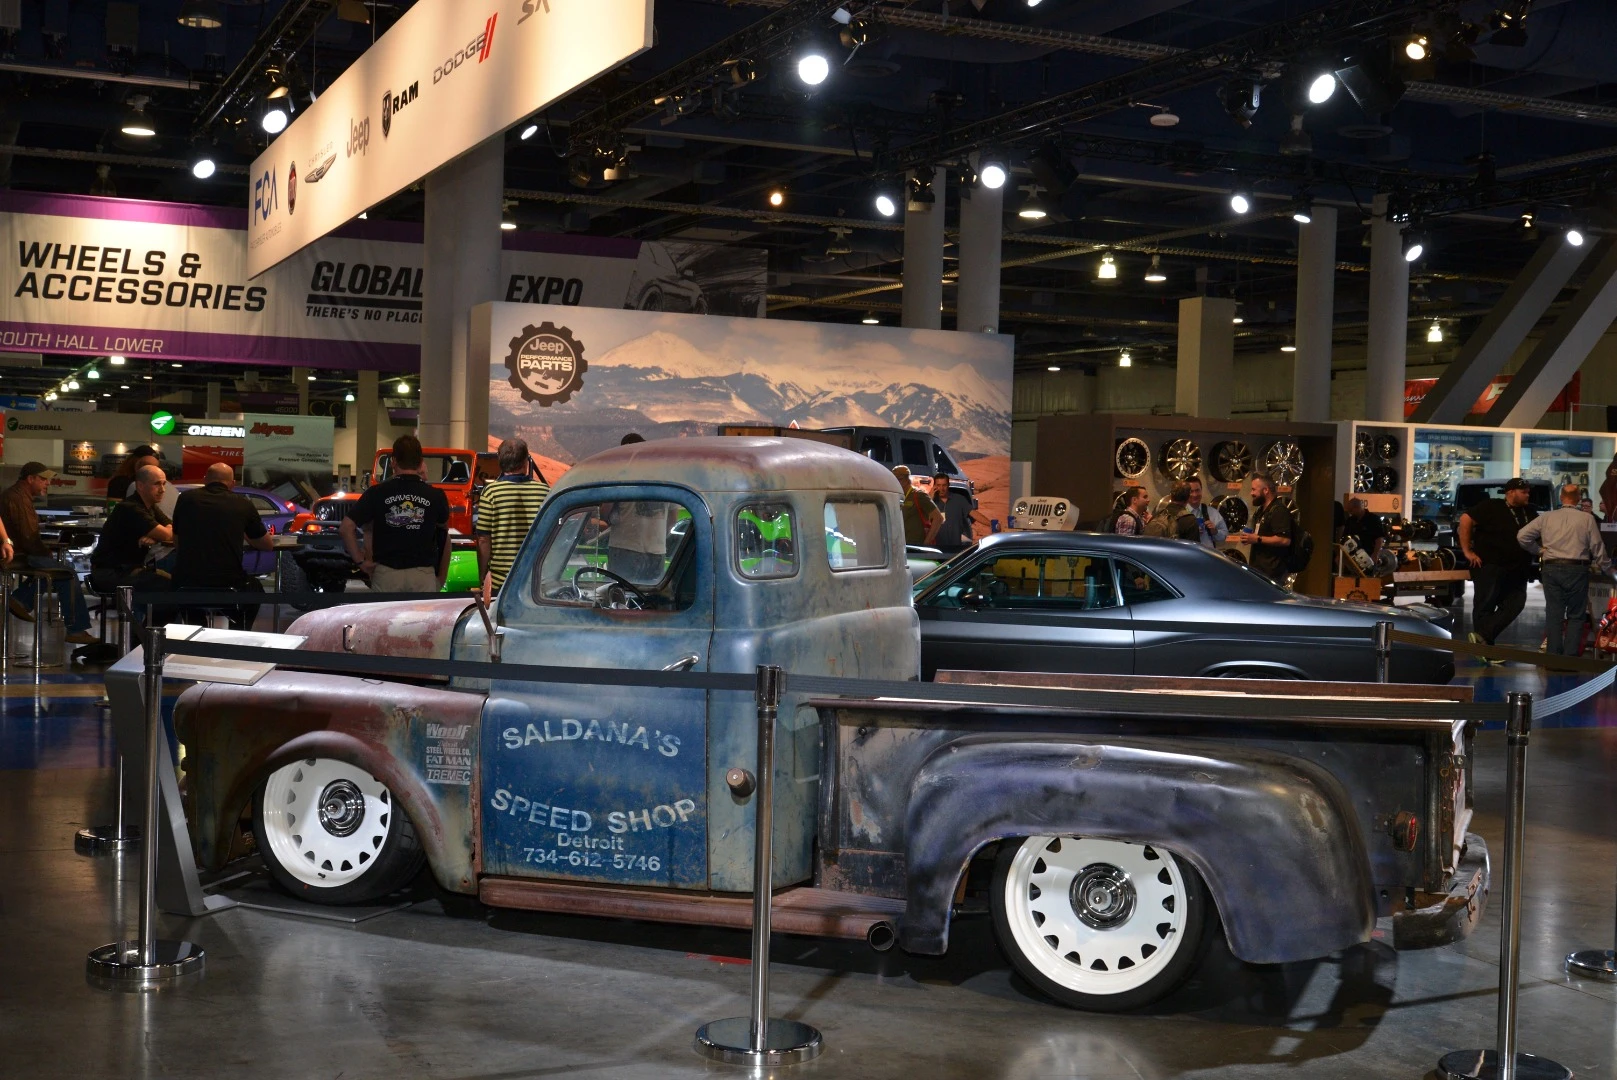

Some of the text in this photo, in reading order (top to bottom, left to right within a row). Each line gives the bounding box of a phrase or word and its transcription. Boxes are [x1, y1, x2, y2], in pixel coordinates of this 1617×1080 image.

[432, 30, 487, 86] DODGE
[392, 80, 419, 115] RAM
[346, 115, 370, 158] Jeep
[254, 163, 278, 227] FCA
[19, 240, 202, 278] WHEELS &
[310, 261, 424, 298] GLOBAL
[505, 274, 584, 306] EXPO
[14, 271, 268, 312] ACCESSORIES
[305, 306, 360, 320] THERE'S
[364, 309, 382, 321] NO
[0, 331, 164, 353] OUTH HALL LOWER
[529, 338, 565, 355] Jeep
[520, 354, 573, 362] PERFORMANCE
[520, 360, 573, 372] PARTS
[249, 422, 294, 438] Myers
[384, 494, 431, 507] GRAVEYARD
[502, 718, 682, 758] SALDANA'S
[426, 746, 443, 755] STEEL
[426, 755, 471, 766] FAT MAN
[427, 769, 471, 781] TREMEC
[490, 788, 696, 834] SPEED SHOP
[557, 832, 625, 851] Detroit
